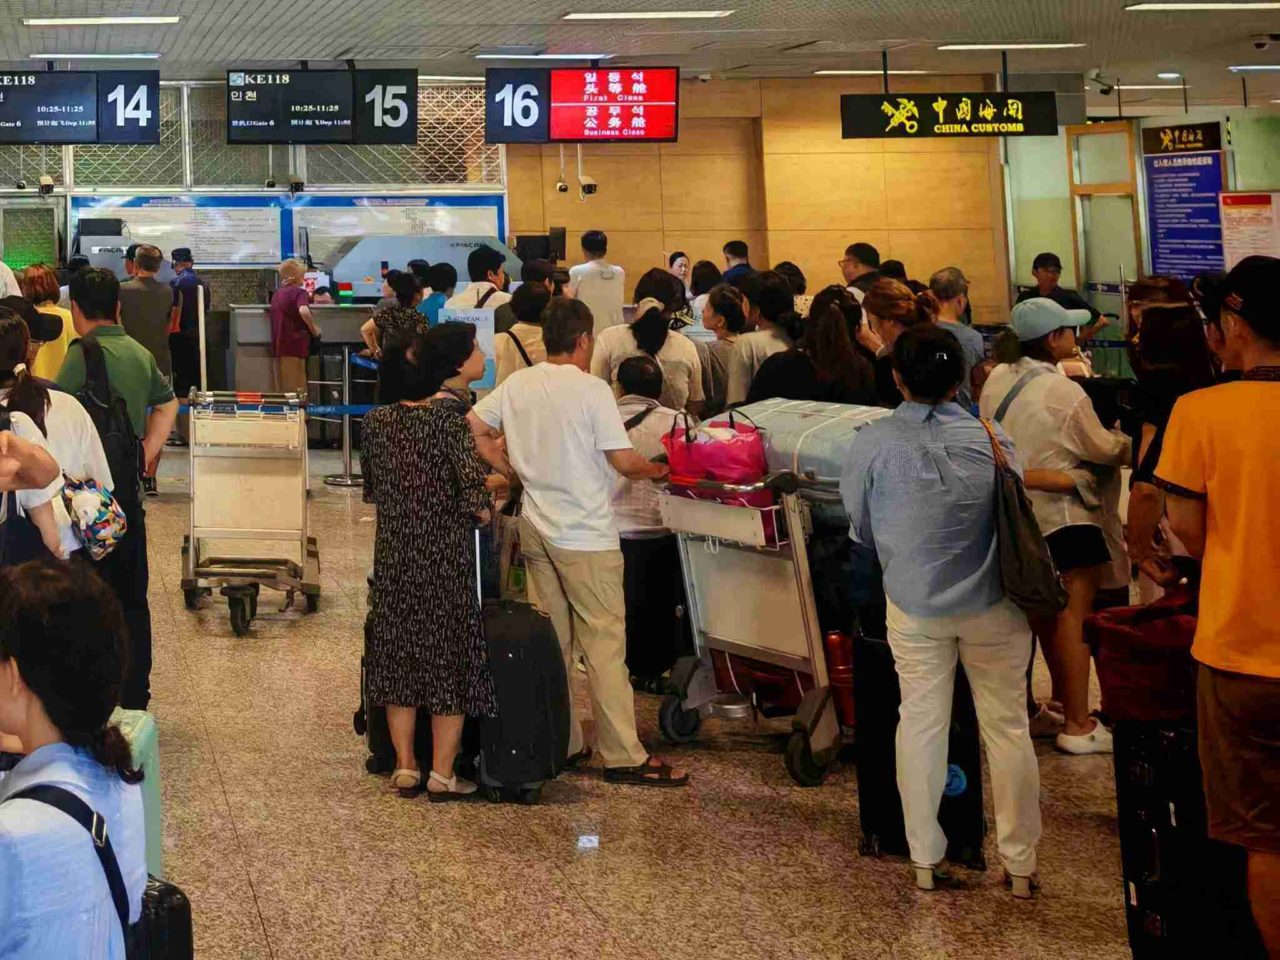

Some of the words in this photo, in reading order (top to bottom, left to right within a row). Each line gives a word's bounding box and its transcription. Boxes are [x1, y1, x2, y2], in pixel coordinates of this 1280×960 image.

[244, 74, 290, 84] KE118
[107, 84, 152, 127] 14
[365, 84, 409, 127] 15
[495, 83, 540, 127] 16
[932, 97, 1023, 123] 中国海关
[934, 124, 968, 133] CHINA
[971, 123, 1024, 133] CUSTOMS
